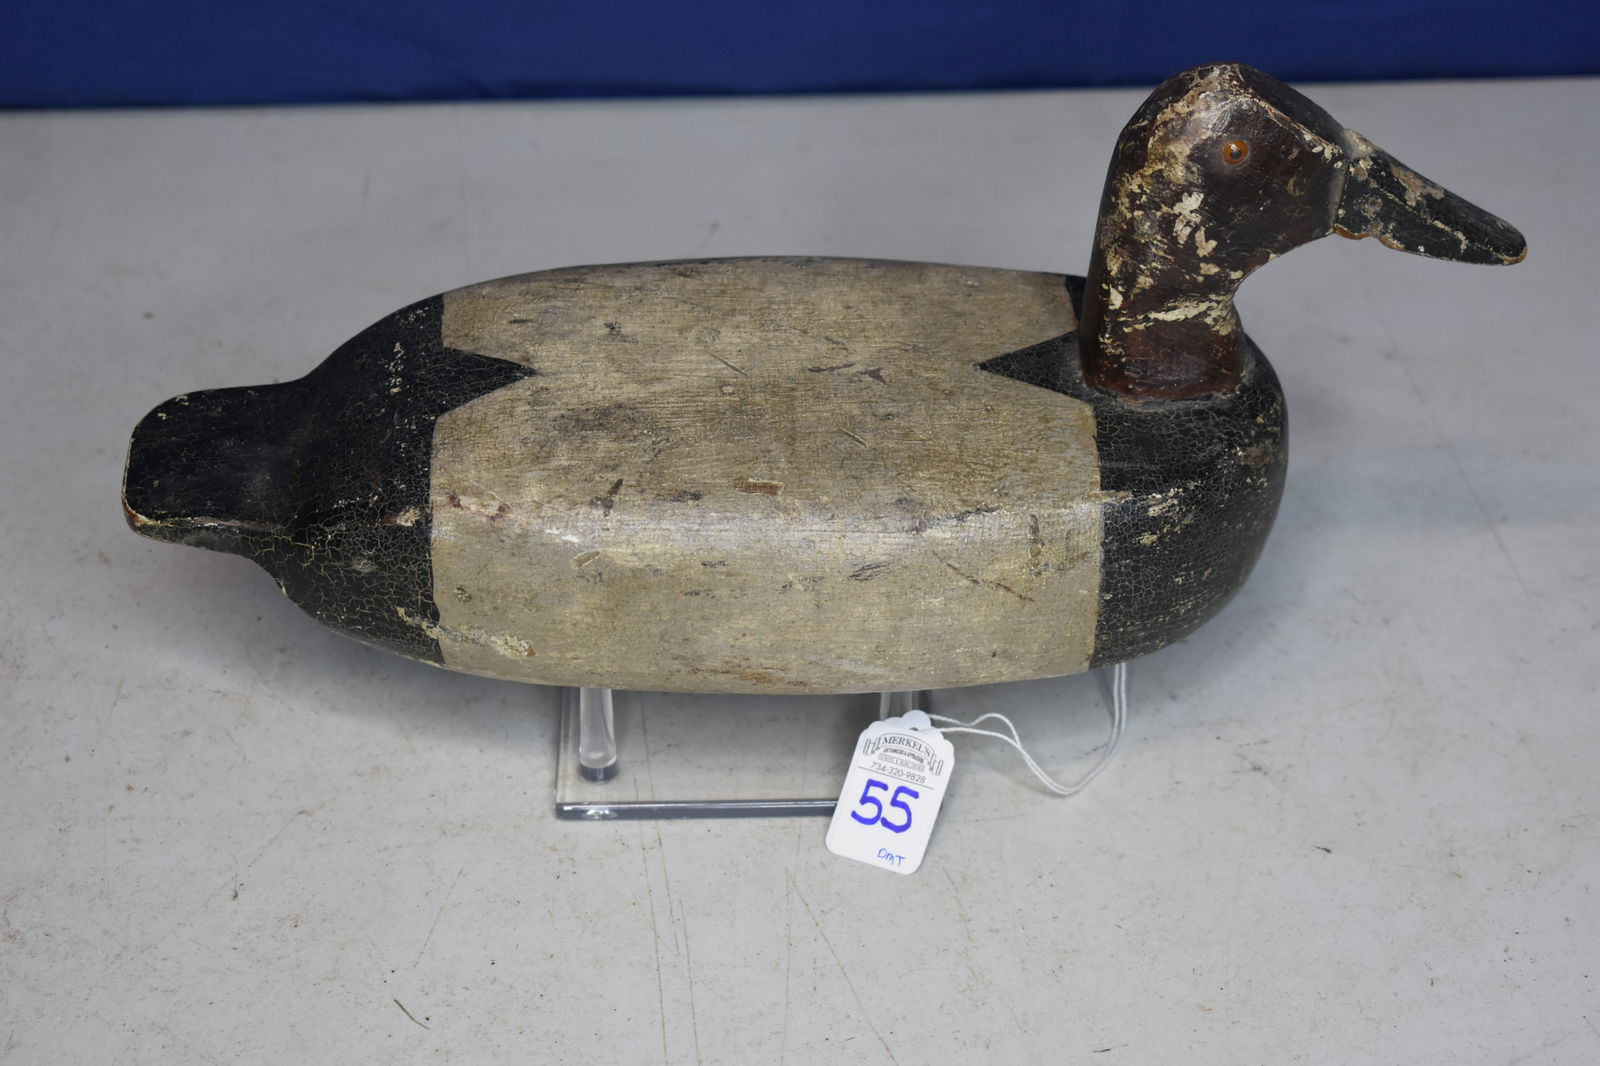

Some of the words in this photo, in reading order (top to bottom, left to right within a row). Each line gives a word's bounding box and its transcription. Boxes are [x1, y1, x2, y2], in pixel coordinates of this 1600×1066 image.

[882, 736, 931, 757] MERKEL'S
[871, 761, 926, 784] 734-320-9828
[851, 778, 919, 833] 55
